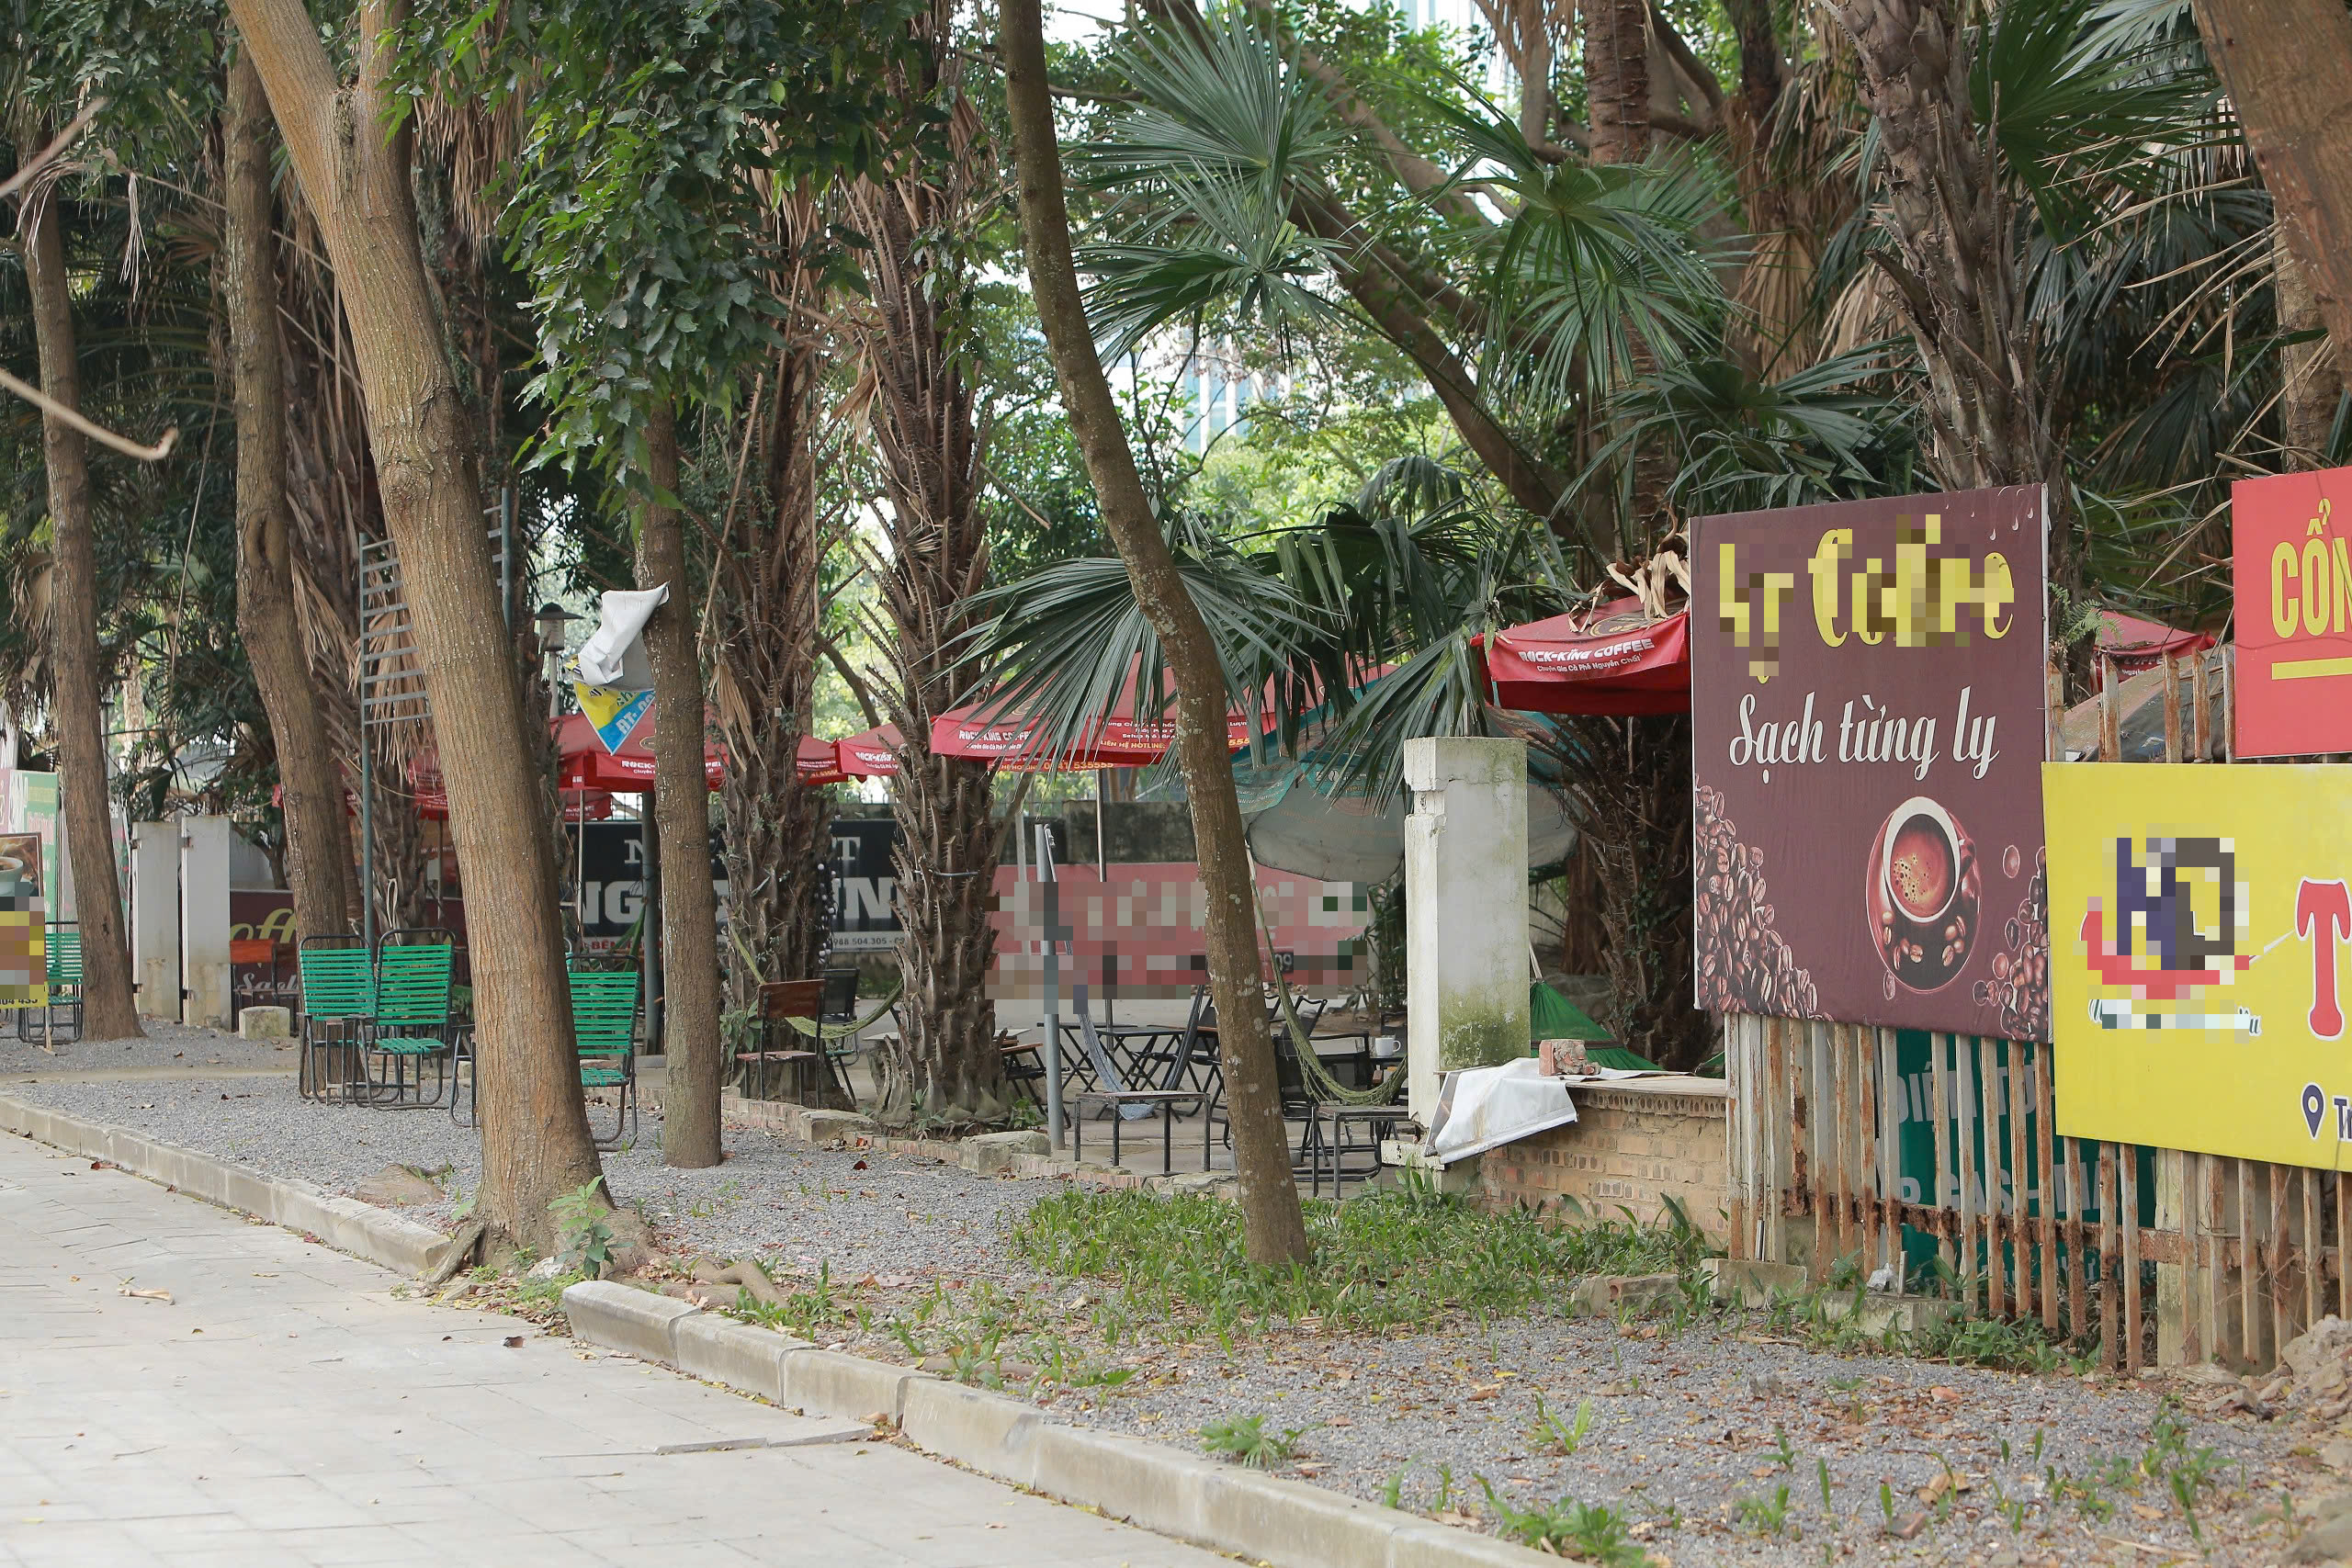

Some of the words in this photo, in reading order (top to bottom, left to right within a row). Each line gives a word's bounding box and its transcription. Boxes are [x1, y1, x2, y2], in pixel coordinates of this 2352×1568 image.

[1594, 637, 1655, 658] COFFEE
[1568, 663, 1578, 671] Cà
[1579, 662, 1591, 671] Phê
[1592, 660, 1620, 671] Nguyên
[1729, 691, 1827, 784] Sạch
[1838, 694, 1939, 781] từng
[1952, 685, 2000, 781] ly
